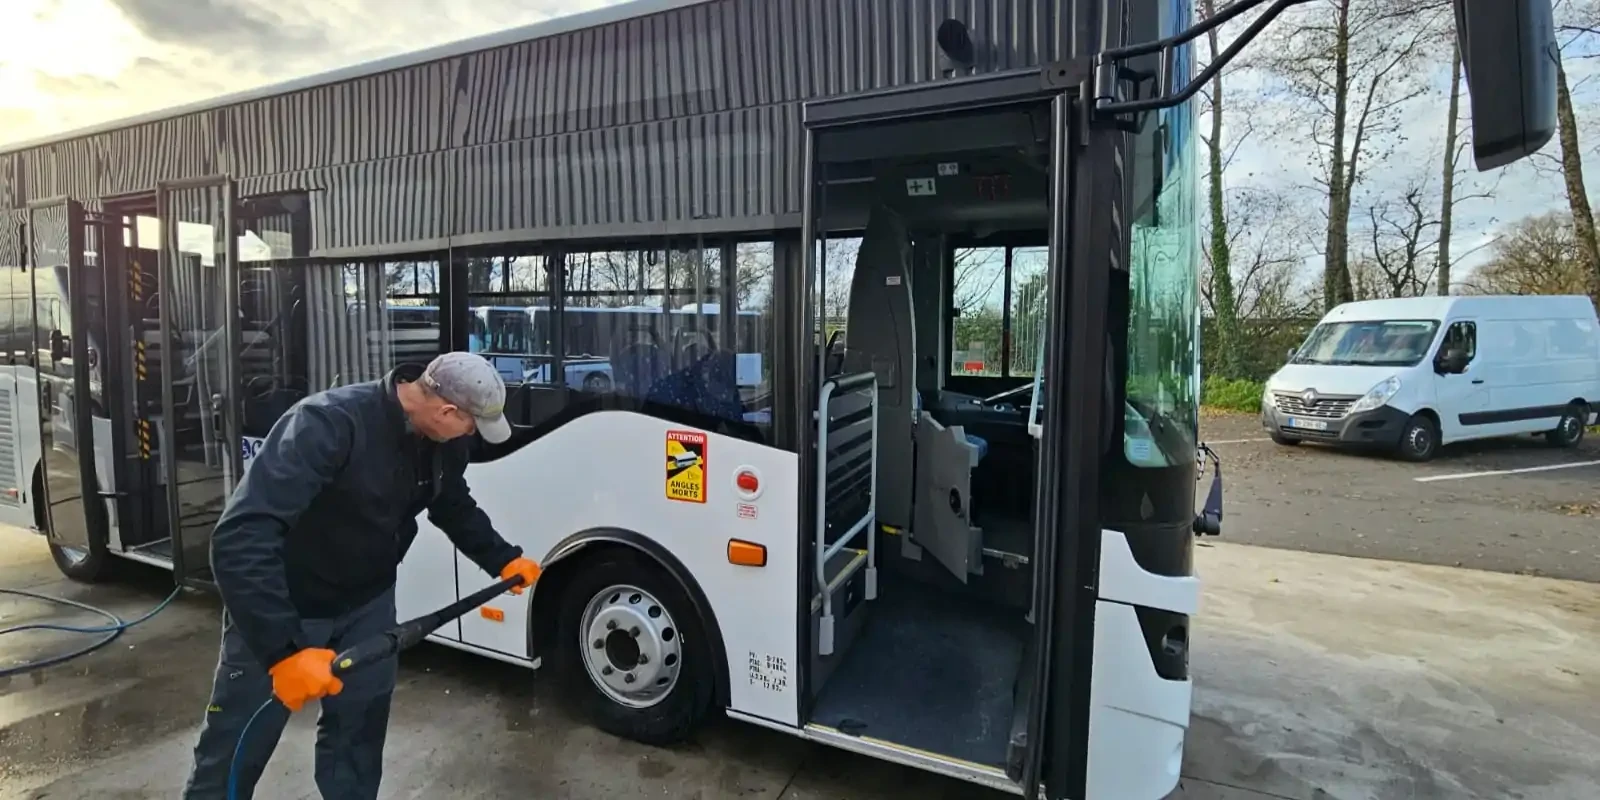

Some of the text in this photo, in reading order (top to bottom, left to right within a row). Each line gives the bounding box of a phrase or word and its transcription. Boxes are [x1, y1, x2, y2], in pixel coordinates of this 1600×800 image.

[668, 432, 704, 443] ATTENTION
[671, 481, 699, 491] ANGLES
[672, 489, 698, 498] MORTS
